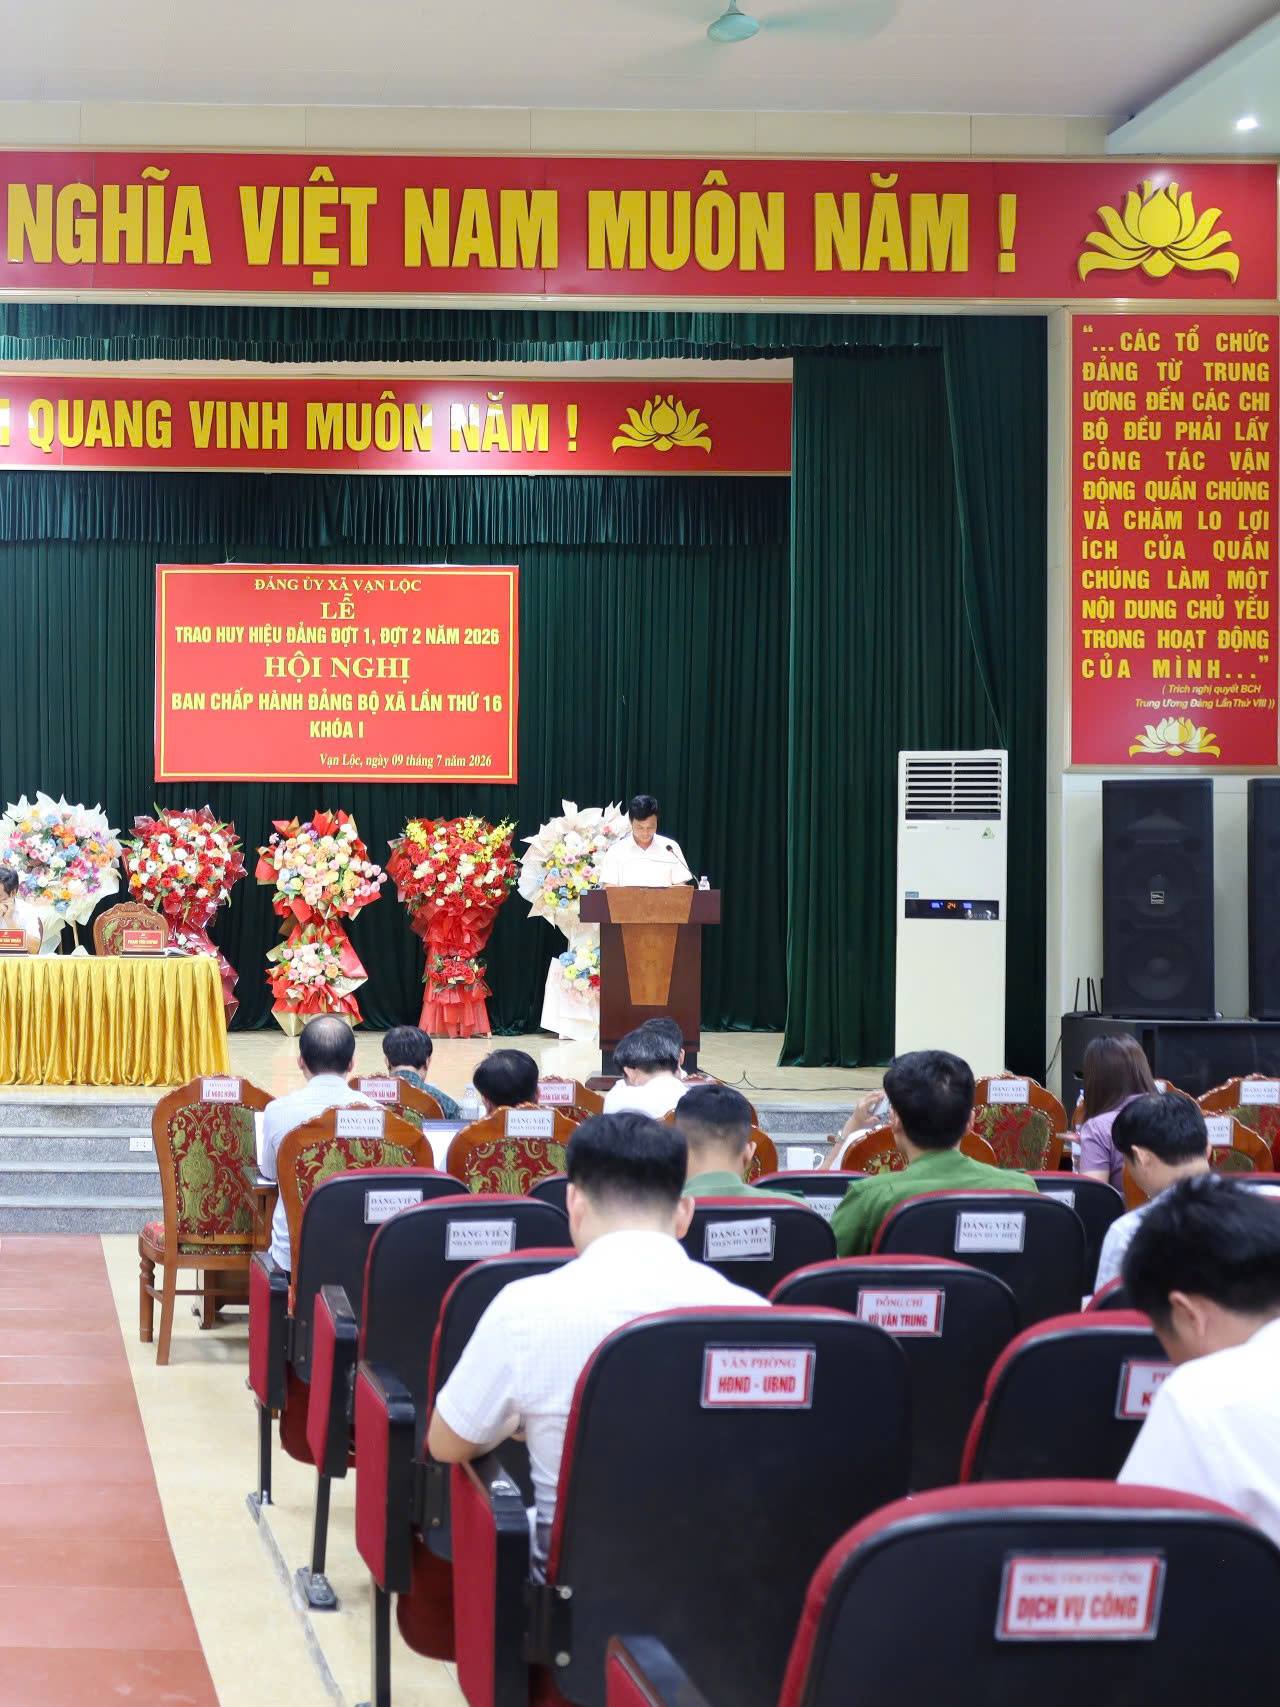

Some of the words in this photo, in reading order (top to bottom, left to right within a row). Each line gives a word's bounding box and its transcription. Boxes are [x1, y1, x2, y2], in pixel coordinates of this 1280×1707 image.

[7, 166, 211, 266] NGHĨA
[239, 166, 377, 286] VIỆT
[404, 188, 558, 269] NAM
[588, 170, 785, 272] MUÔN
[815, 172, 969, 272] NĂM
[1175, 324, 1200, 351] TỔ
[1216, 329, 1270, 352] CHỨC
[1082, 355, 1138, 382] ĐẢNG
[1157, 358, 1183, 381] TỪ
[1204, 362, 1269, 382] TRUNG
[29, 398, 172, 453] QUANG
[189, 401, 288, 451] VINH
[306, 391, 431, 452] MUÔN
[450, 391, 549, 454] NĂM
[1083, 477, 1135, 504] ĐỘNG
[1206, 477, 1269, 500] CHÚNG
[1082, 537, 1117, 560] ÍCH
[1144, 534, 1186, 560] CỦA
[328, 577, 348, 591] XÃ
[352, 579, 386, 596] VẠN
[389, 578, 421, 596] LỘC
[1082, 567, 1150, 589] CHÚNG
[1168, 567, 1210, 589] LÀM
[1227, 567, 1269, 594] MỘT
[321, 593, 356, 619] LỄ
[176, 626, 211, 643] TRAO
[217, 627, 244, 643] HUY
[249, 624, 282, 647] HIỆU
[286, 622, 327, 644] ĐẢNG
[331, 627, 358, 648] ĐỢT
[363, 628, 375, 646] 1,
[380, 628, 409, 649] ĐỢT
[412, 629, 421, 644] 2
[426, 625, 459, 645] NĂM
[464, 629, 499, 645] 2026
[1082, 630, 1145, 649] TRONG
[1157, 630, 1207, 652] HOẠT
[1217, 625, 1269, 652] ĐỘNG
[264, 651, 321, 682] HỘI
[331, 656, 410, 684] NGHỊ
[1082, 653, 1131, 678] CỦA
[172, 693, 205, 711] BAN
[211, 688, 253, 711] CHẤP
[259, 690, 303, 711] HÀNH
[308, 689, 352, 711] ĐẢNG
[358, 691, 380, 715] BỘ
[385, 692, 406, 712] XÃ
[411, 690, 442, 712] LẦN
[448, 692, 479, 712] THỨ
[483, 695, 502, 712] 16
[1135, 698, 1160, 709] Trung
[310, 717, 351, 738] KHÓA
[359, 721, 364, 738] I
[320, 753, 339, 769] Vạn
[342, 753, 363, 768] Lộc,
[366, 755, 389, 769] ngày
[392, 754, 403, 766] 09
[406, 754, 434, 769] tháng
[436, 755, 442, 766] 7
[445, 755, 466, 766] năm
[469, 755, 492, 767] 2026
[763, 1376, 796, 1393] UBND
[1017, 1596, 1057, 1626] DỊCH
[1090, 1590, 1138, 1619] CÔNG
